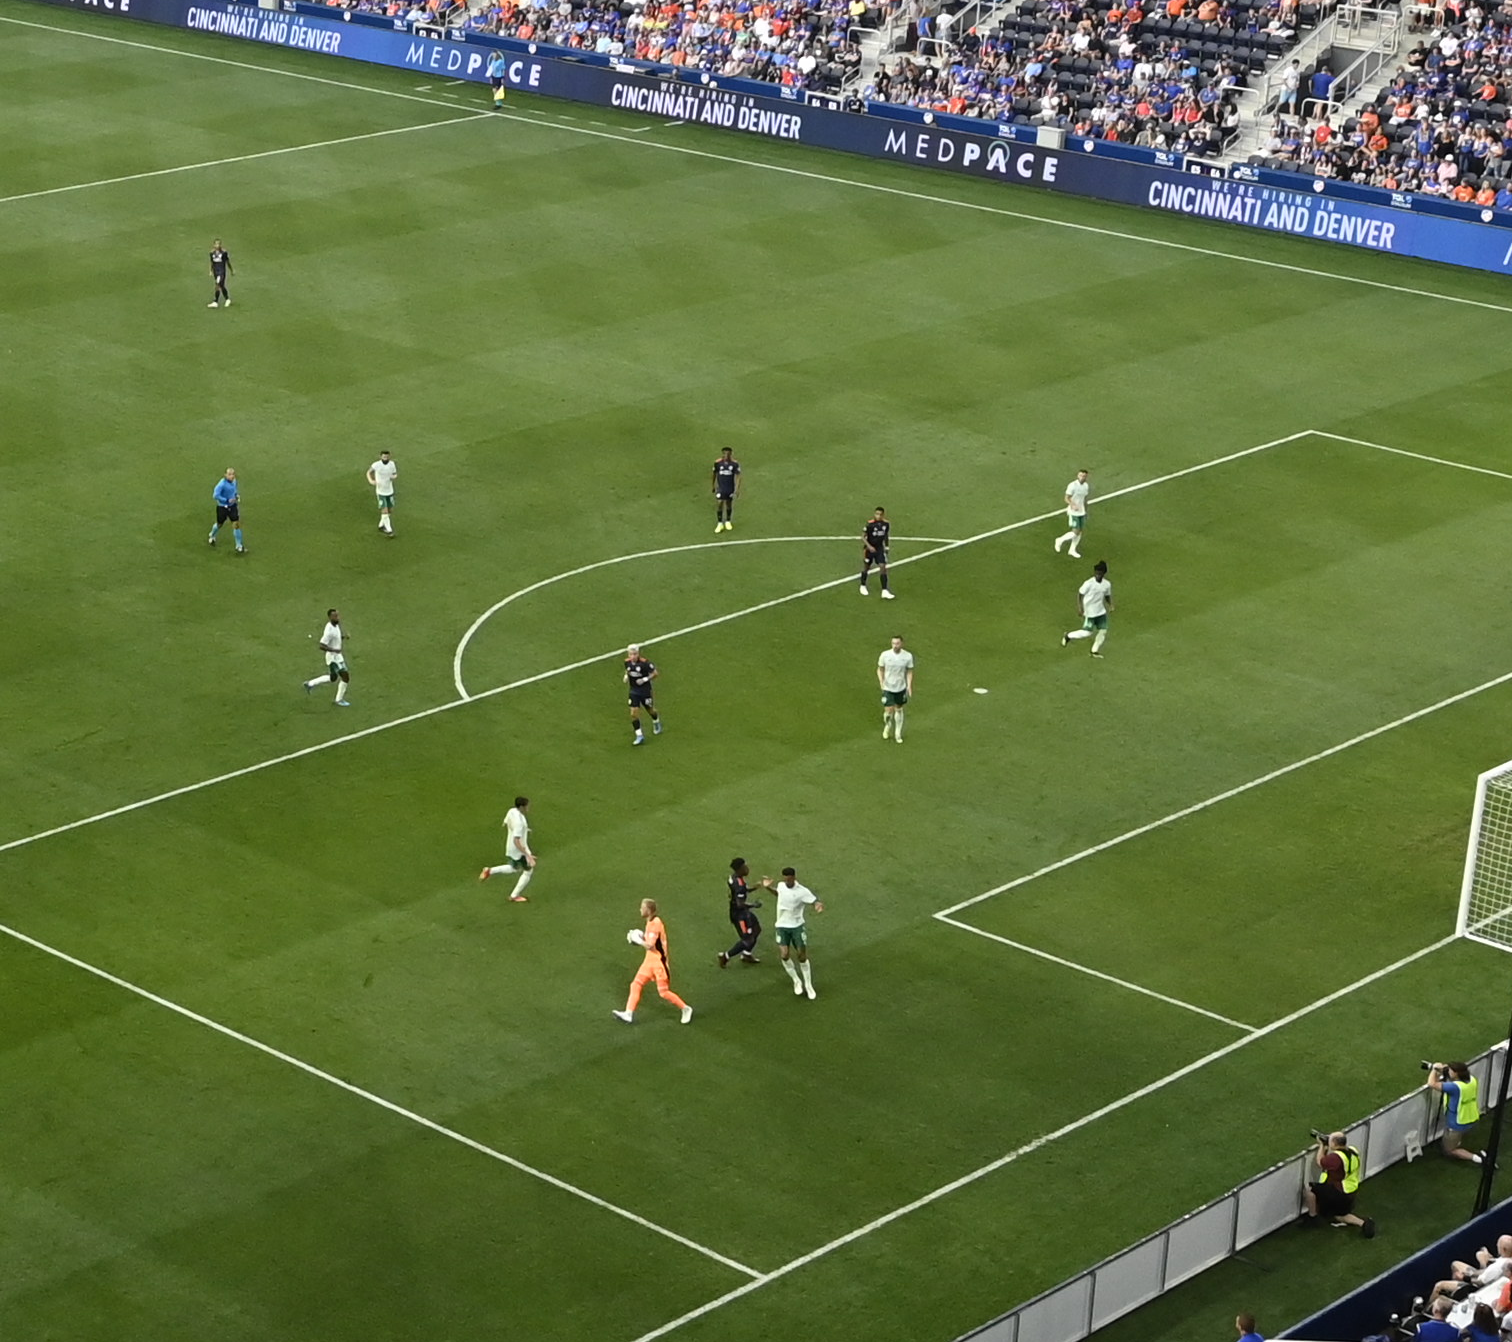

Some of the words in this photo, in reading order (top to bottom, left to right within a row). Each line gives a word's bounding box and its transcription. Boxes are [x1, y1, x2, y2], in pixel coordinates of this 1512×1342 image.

[187, 7, 257, 39] CINCINNATI
[258, 21, 287, 44] AND
[289, 25, 342, 54] DENVER
[405, 42, 542, 87] MEDPCE
[611, 83, 698, 121] CINCINNATI
[700, 101, 735, 128] AND
[737, 106, 802, 139] DENVER
[698, 86, 738, 104] HIRING
[742, 95, 755, 106] IN
[884, 128, 1059, 183] MEDPACE
[1148, 180, 1262, 225] CINCINNATI
[1264, 201, 1311, 233] AND
[1313, 211, 1396, 249] DENVER
[1212, 179, 1255, 197] WE'RE
[1262, 187, 1313, 206] HIRING
[1321, 199, 1335, 211] IN
